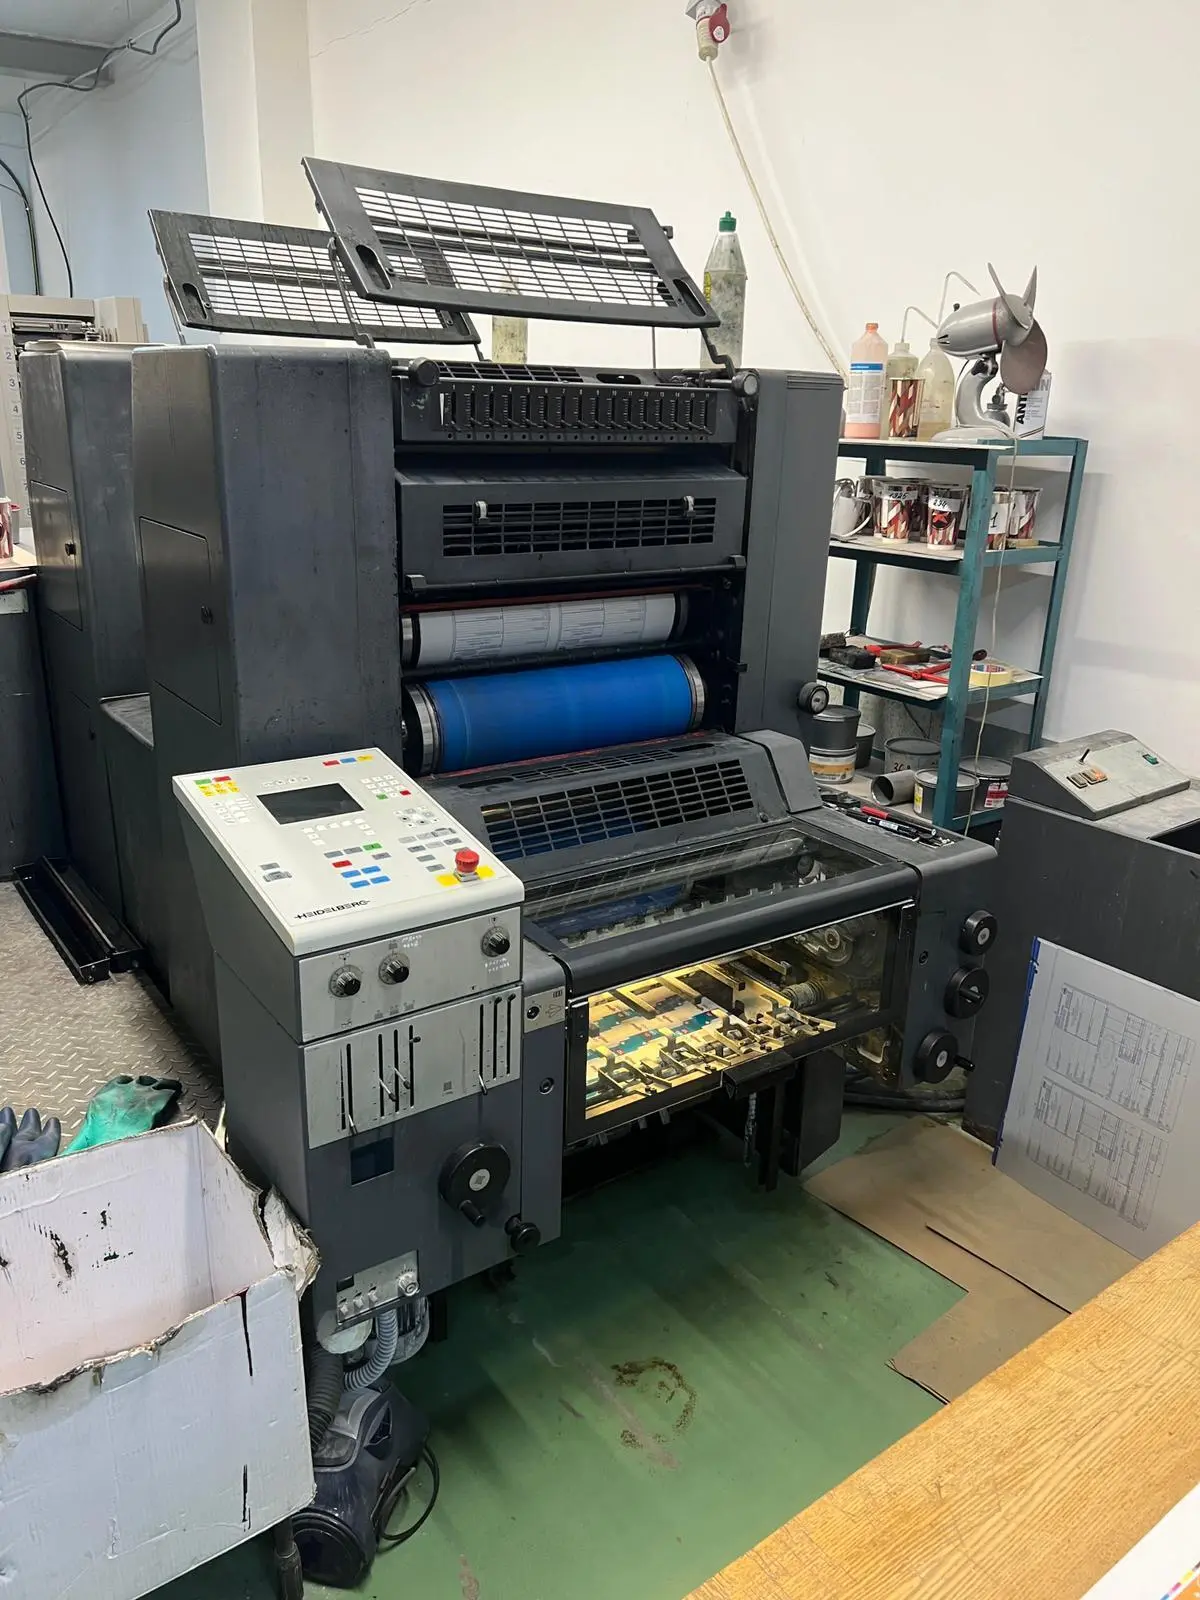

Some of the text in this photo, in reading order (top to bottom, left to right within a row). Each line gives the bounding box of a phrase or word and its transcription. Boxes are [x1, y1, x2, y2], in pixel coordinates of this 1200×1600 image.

[6, 351, 12, 360] 2
[9, 378, 16, 387] 3
[13, 405, 19, 414] 4
[16, 431, 23, 440] 5
[20, 457, 26, 466] 6
[294, 900, 371, 919] HEIDELBERG
